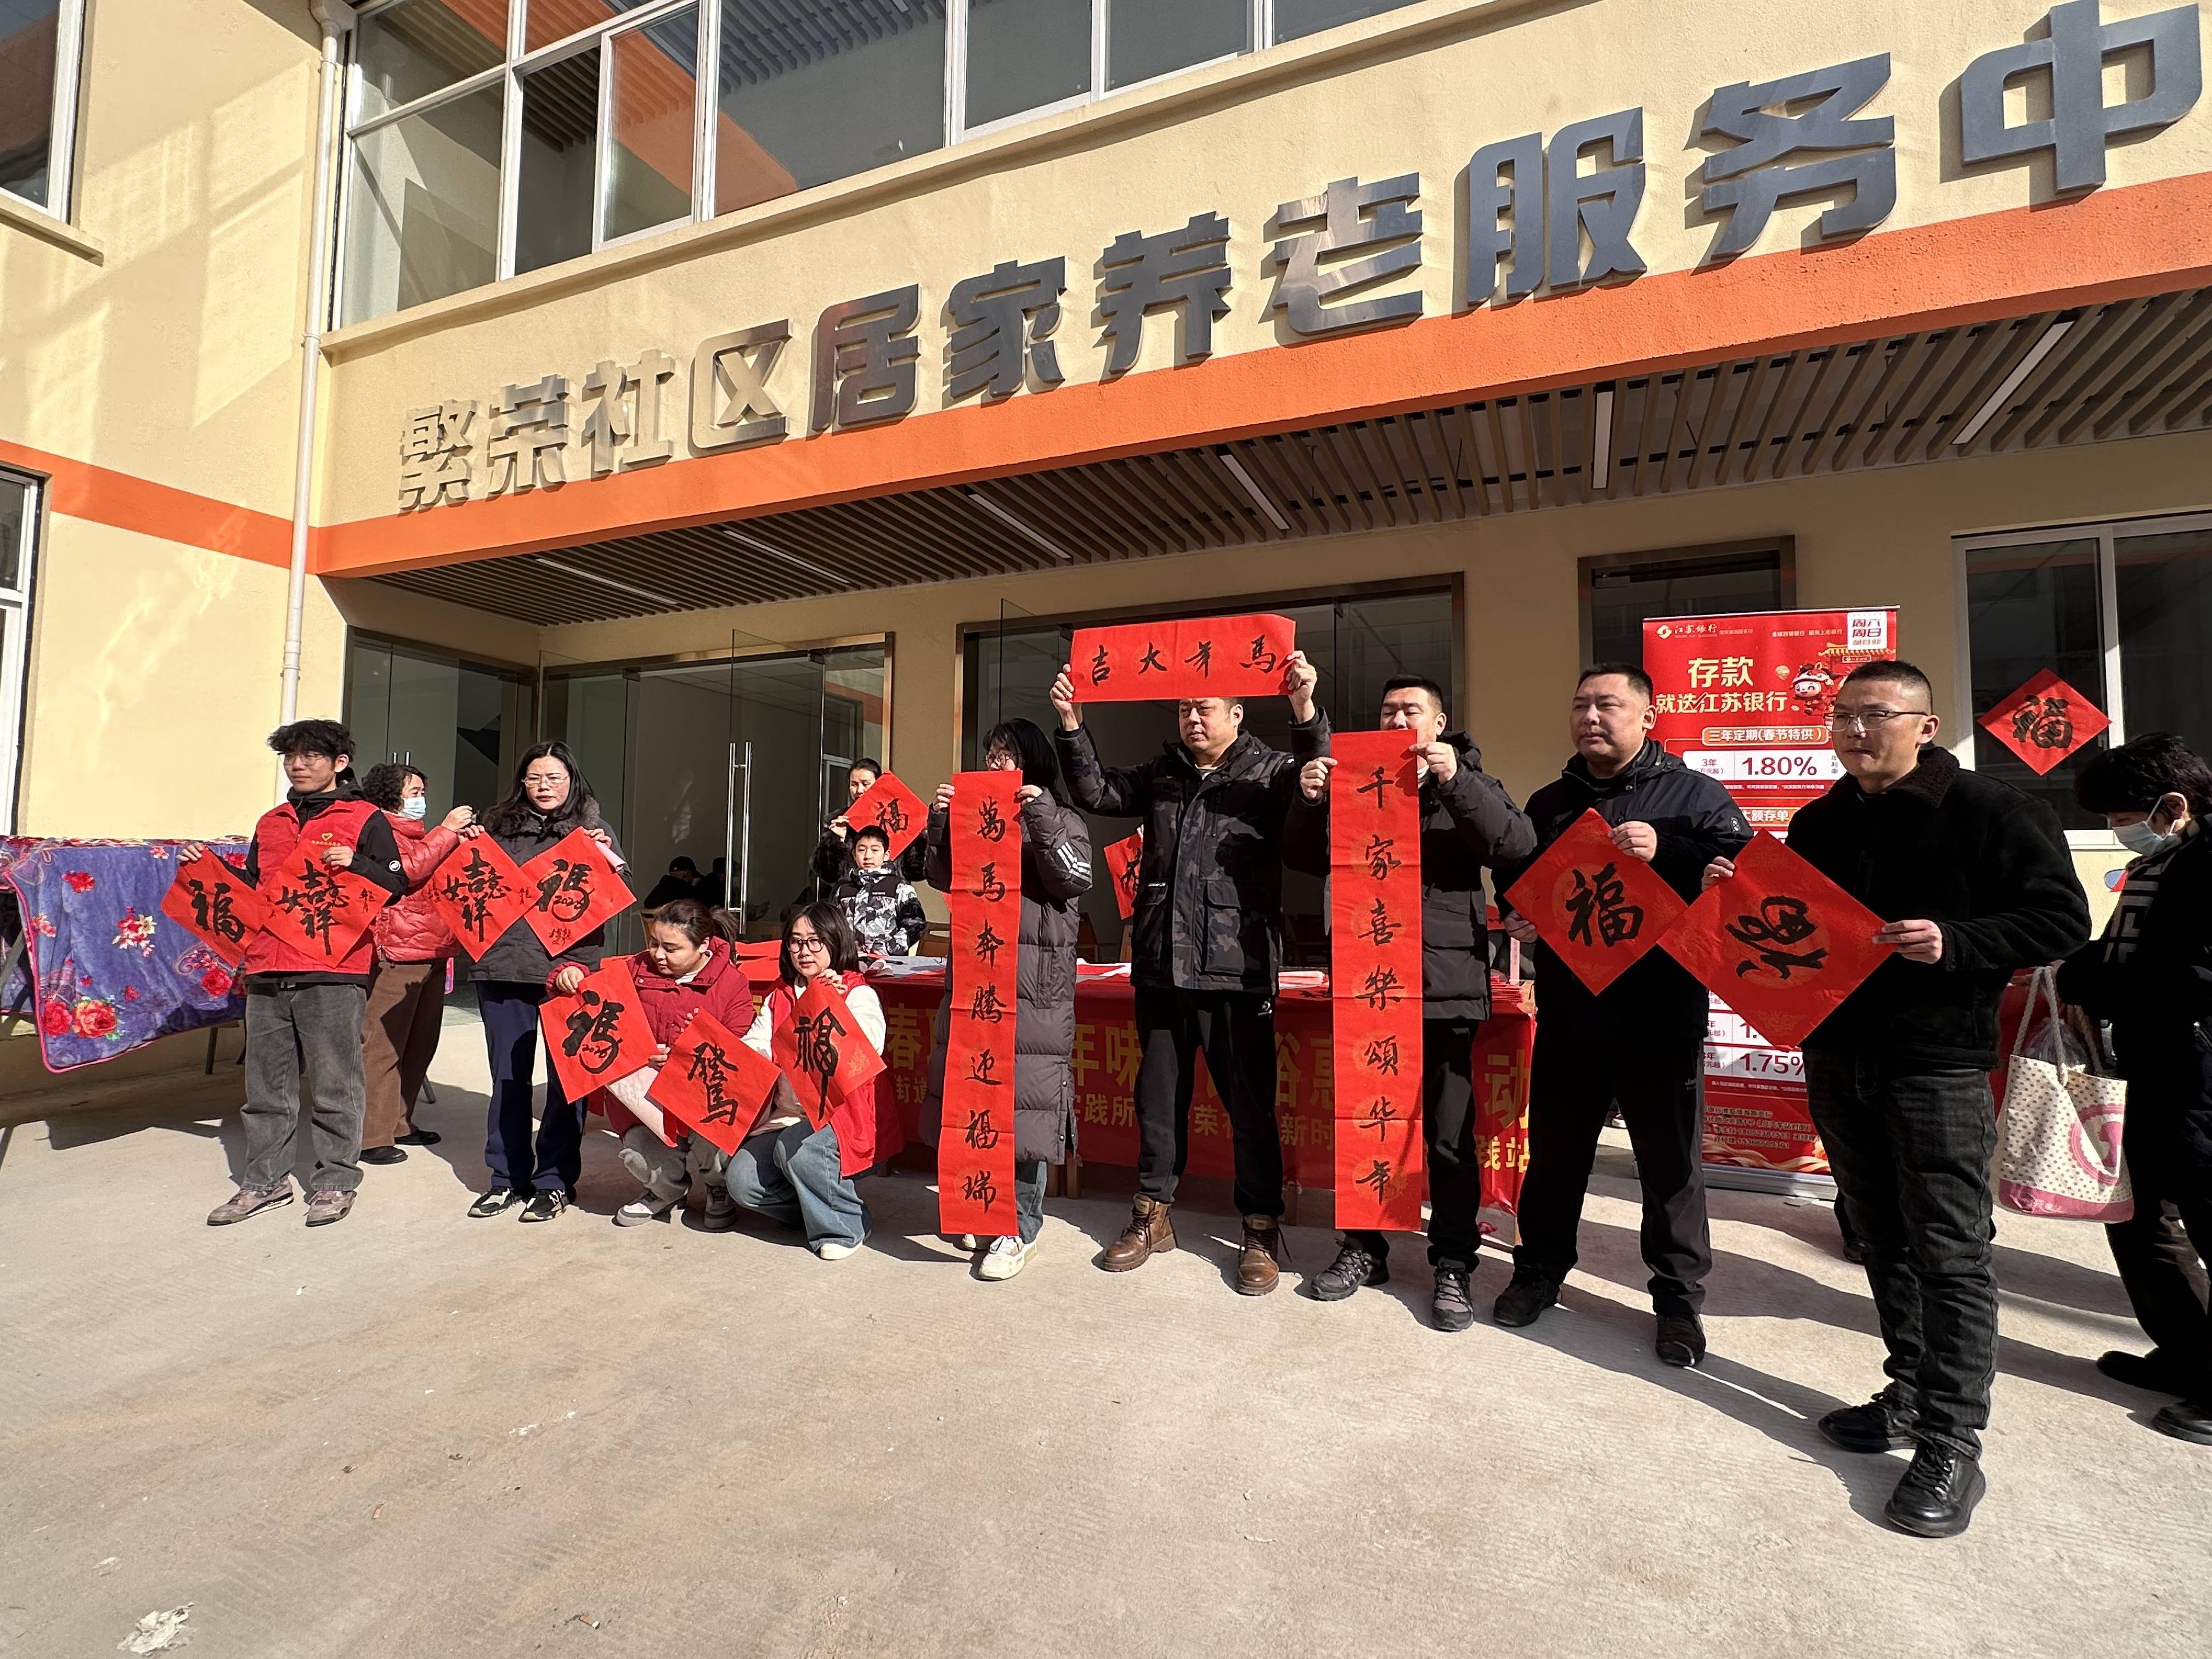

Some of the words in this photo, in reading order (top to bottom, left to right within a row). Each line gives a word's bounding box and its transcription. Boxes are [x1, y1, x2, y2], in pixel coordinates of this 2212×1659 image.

[400, 0, 2202, 510] 繁荣社区居家养老服务中
[1852, 628, 1882, 637] 周日
[1688, 656, 1754, 689] 存款
[1655, 691, 1788, 714] 就选江苏银行
[1702, 758, 1717, 767] 3年
[1741, 757, 1817, 776] 1.80%
[188, 879, 245, 944] 福
[1565, 861, 1644, 948] 福
[1740, 1053, 1804, 1075] 1.75%
